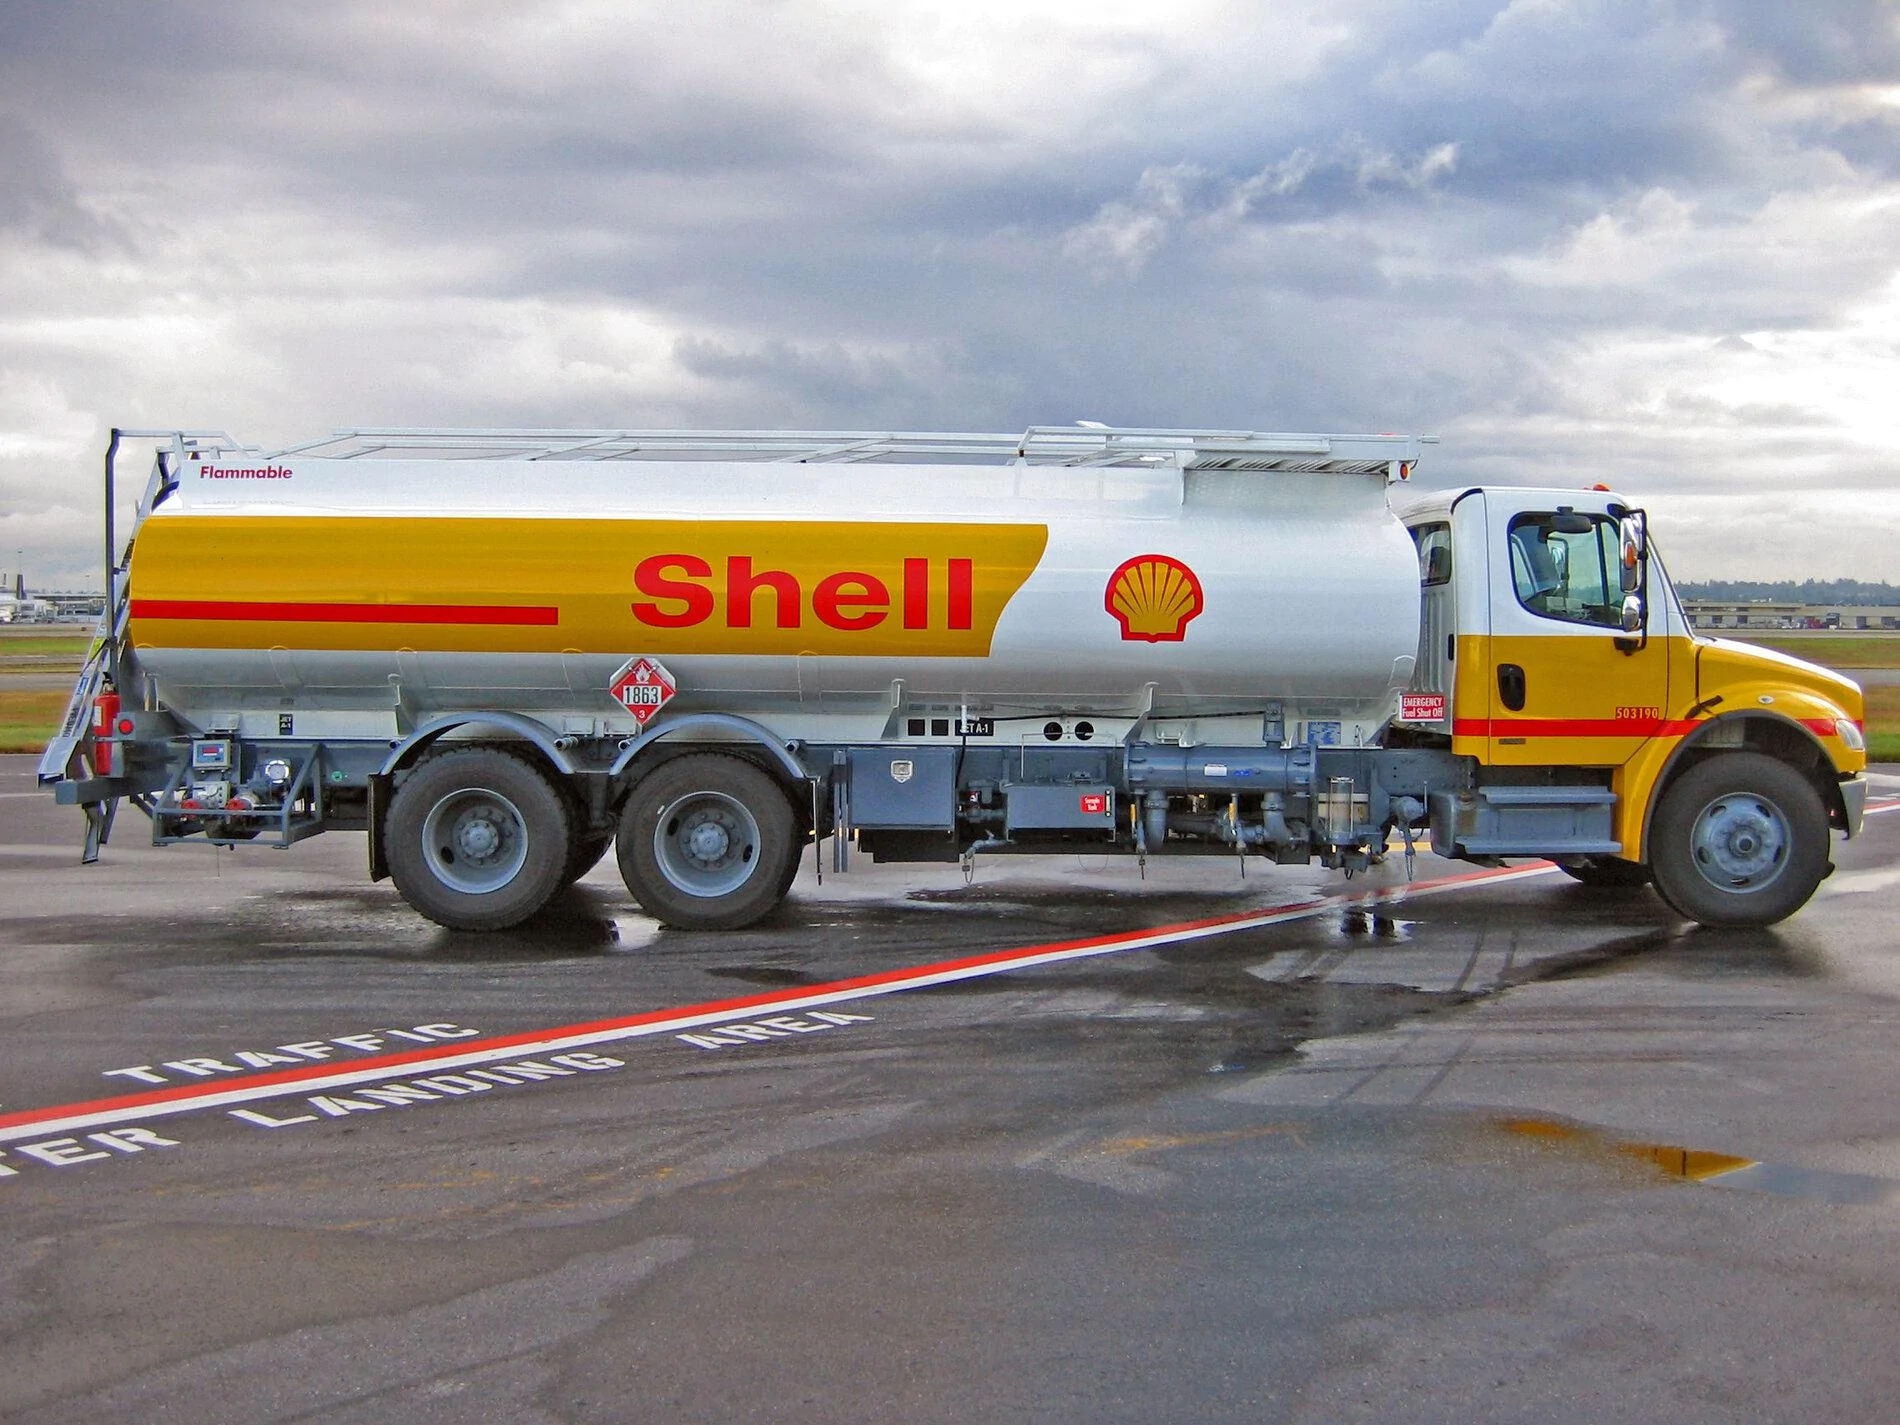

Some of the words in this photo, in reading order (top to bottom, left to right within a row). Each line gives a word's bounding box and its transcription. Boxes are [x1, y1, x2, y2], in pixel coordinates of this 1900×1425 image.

[200, 465, 293, 479] Flammable
[631, 553, 972, 630] Shell
[625, 686, 659, 704] 1863
[1403, 697, 1443, 707] EMERGENCY
[639, 709, 646, 719] 3
[1402, 707, 1416, 717] Fuel
[1416, 707, 1432, 717] Shut
[1432, 707, 1443, 717] Off
[1616, 707, 1658, 719] 503190
[976, 723, 989, 733] A-1
[102, 1023, 480, 1084] TRAFFIC
[0, 1128, 181, 1176] ER
[227, 1052, 626, 1128] LANDING
[675, 1010, 876, 1050] AREA
